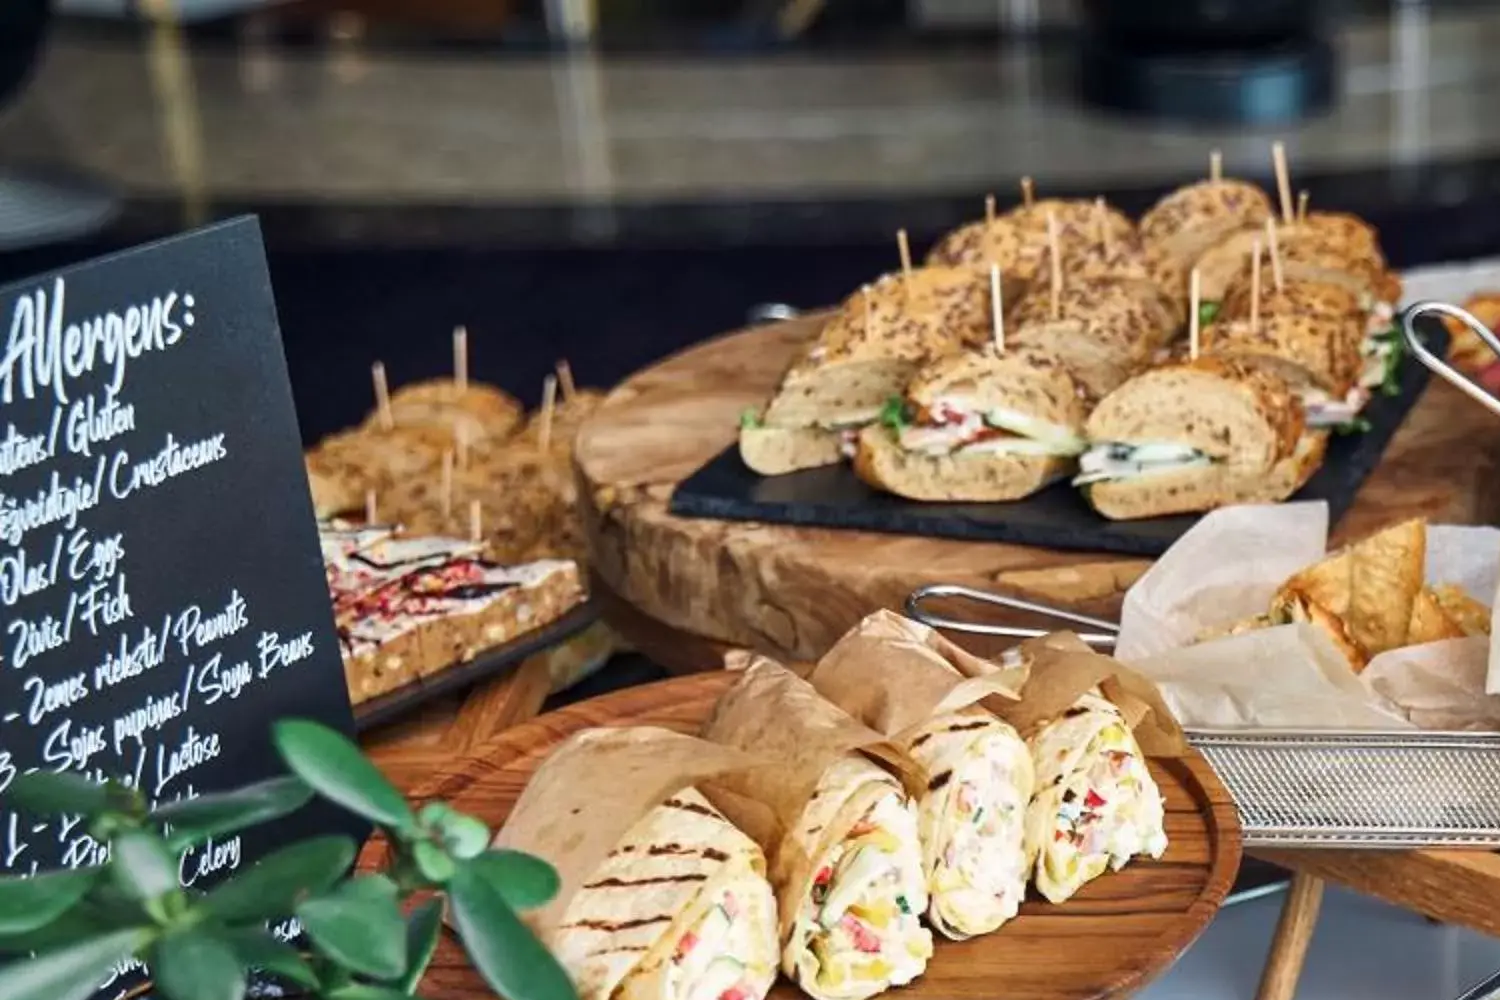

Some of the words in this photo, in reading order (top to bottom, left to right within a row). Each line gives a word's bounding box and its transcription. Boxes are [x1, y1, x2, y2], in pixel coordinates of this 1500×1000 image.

[0, 277, 195, 403] Allergens:
[79, 573, 134, 636] Fish
[173, 589, 249, 656] Peanuts
[155, 726, 221, 796] Lactose
[178, 836, 241, 887] Celery
